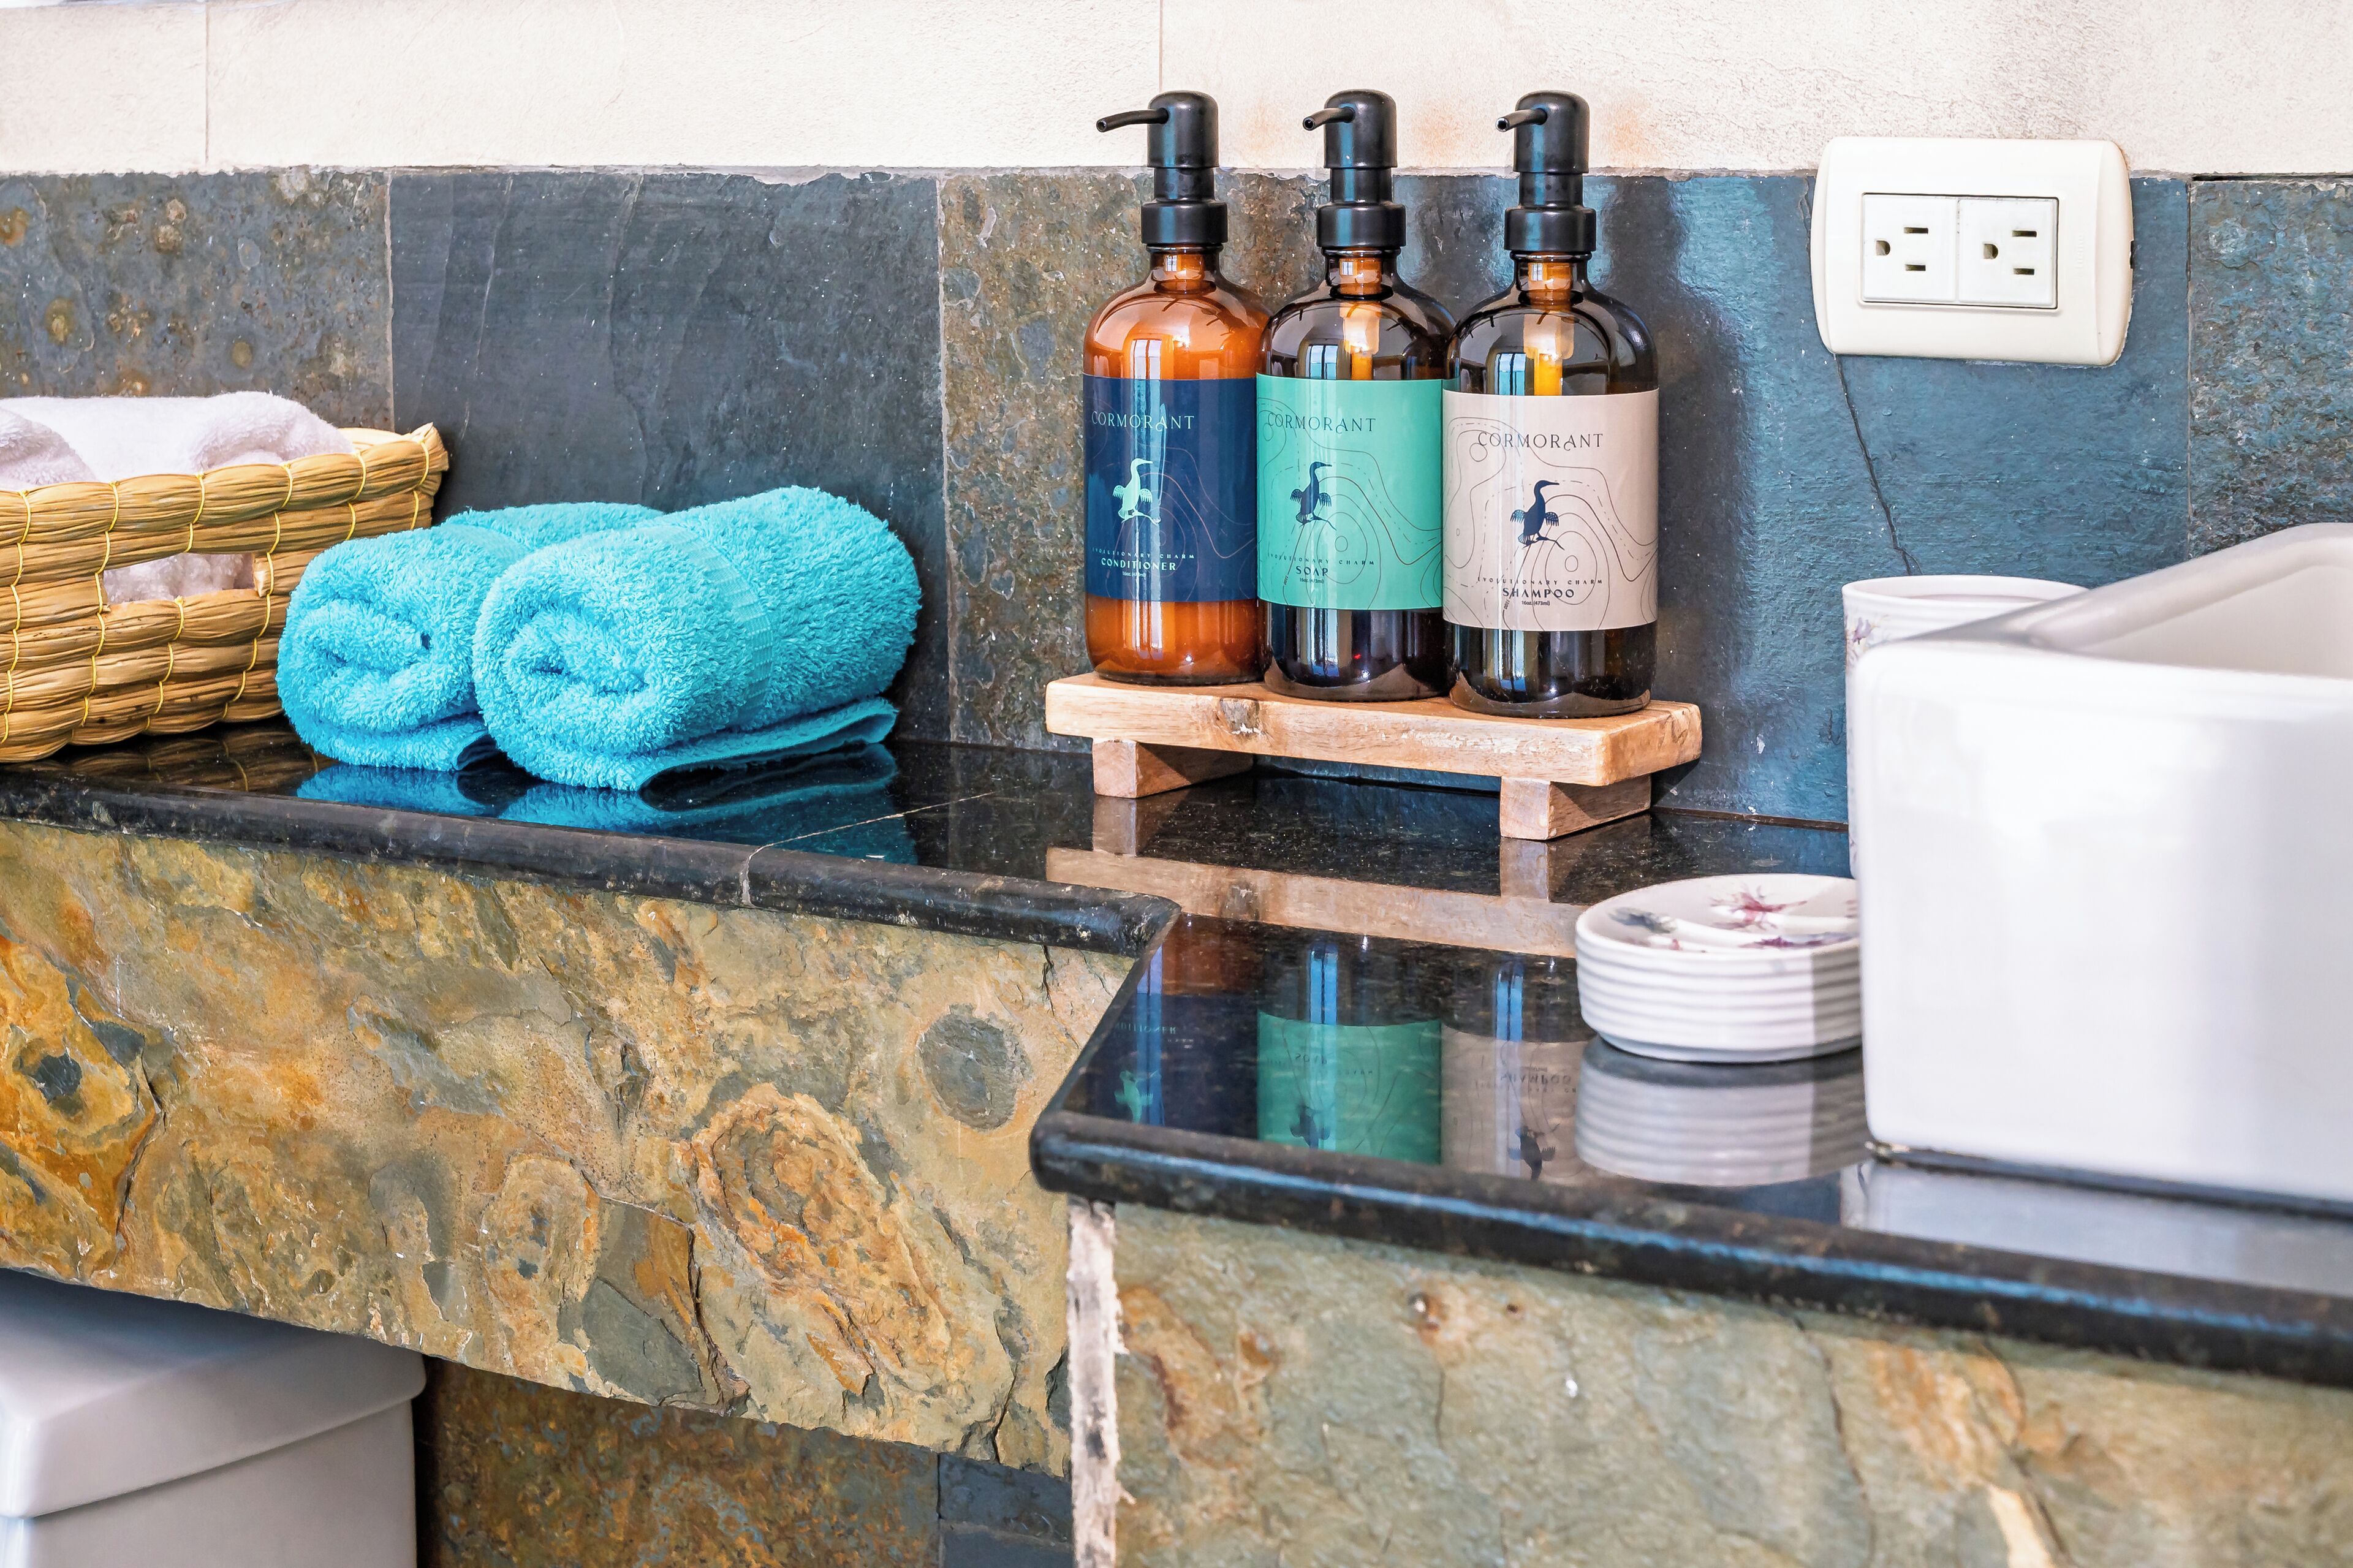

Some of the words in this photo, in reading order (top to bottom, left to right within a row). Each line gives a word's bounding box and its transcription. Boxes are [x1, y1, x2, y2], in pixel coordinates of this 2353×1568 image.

[1091, 411, 1194, 431] CORMORANT
[1268, 412, 1376, 434] CORMORANT
[1478, 432, 1603, 451] CORMORANT
[1101, 558, 1176, 570] CONDITIONER
[1295, 566, 1328, 577] SOAP
[1477, 577, 1558, 585] EVOLUTIONARY
[1502, 588, 1574, 598] SHAMPOO
